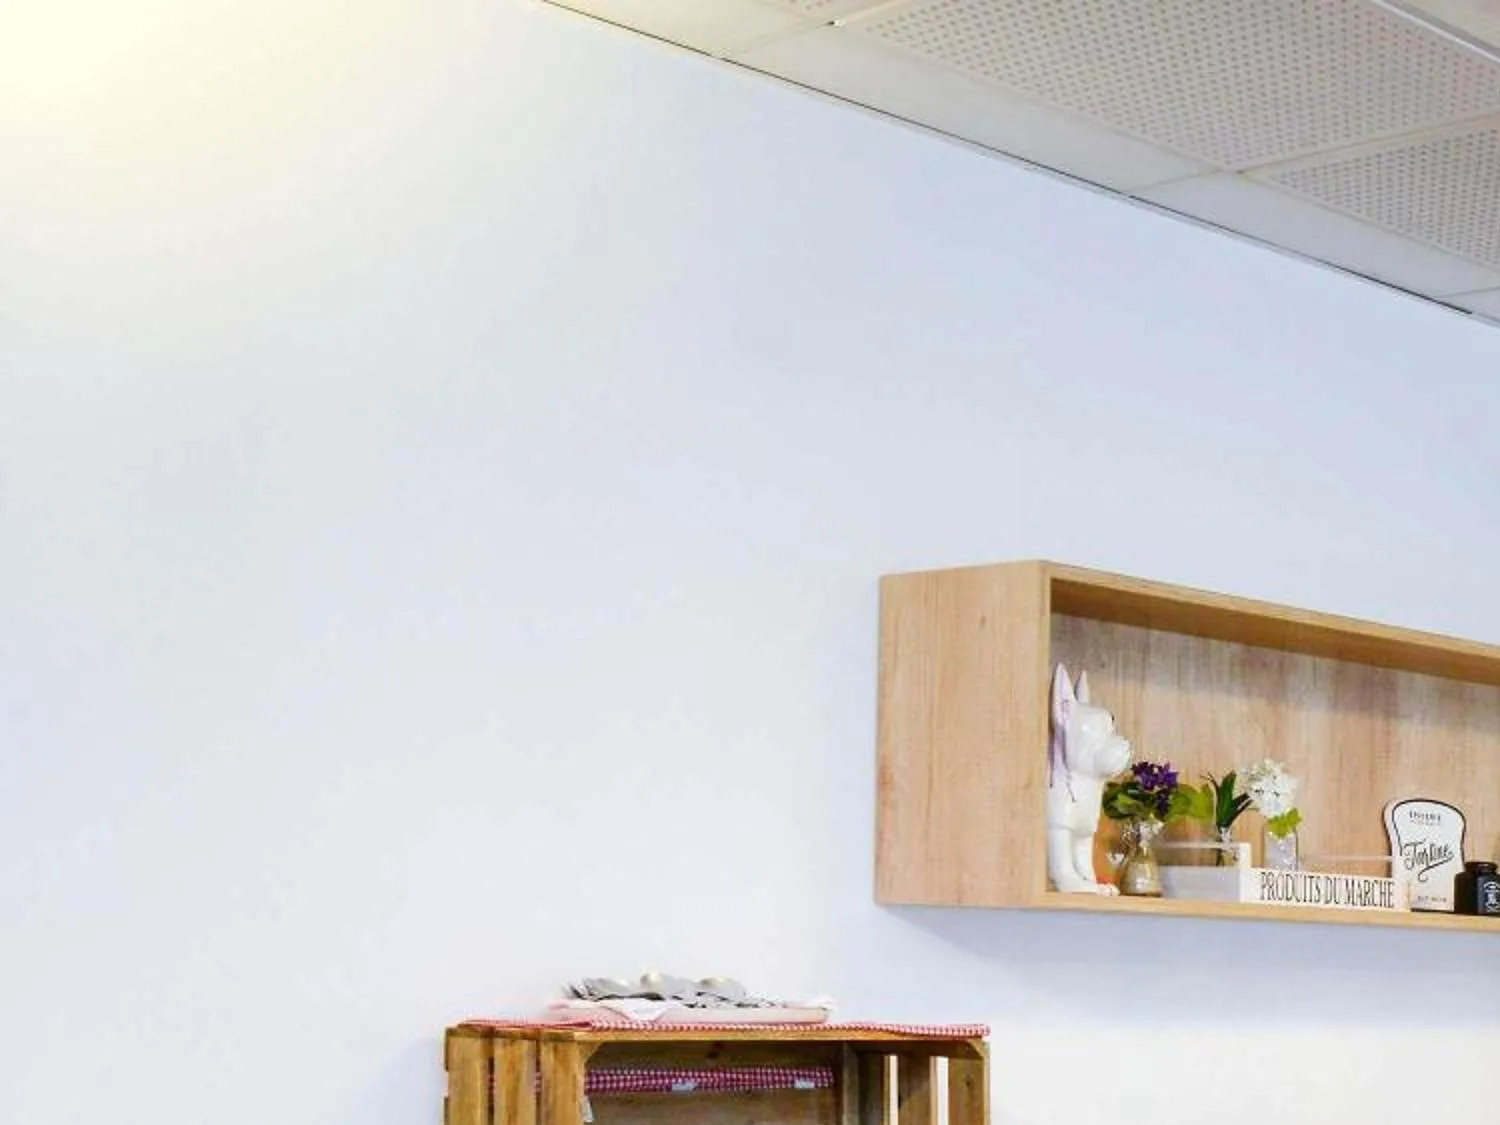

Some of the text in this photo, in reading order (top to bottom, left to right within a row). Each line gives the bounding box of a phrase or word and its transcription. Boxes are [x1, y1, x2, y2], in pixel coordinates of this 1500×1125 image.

[1260, 871, 1395, 908] PRODUITS DU MARCHE
